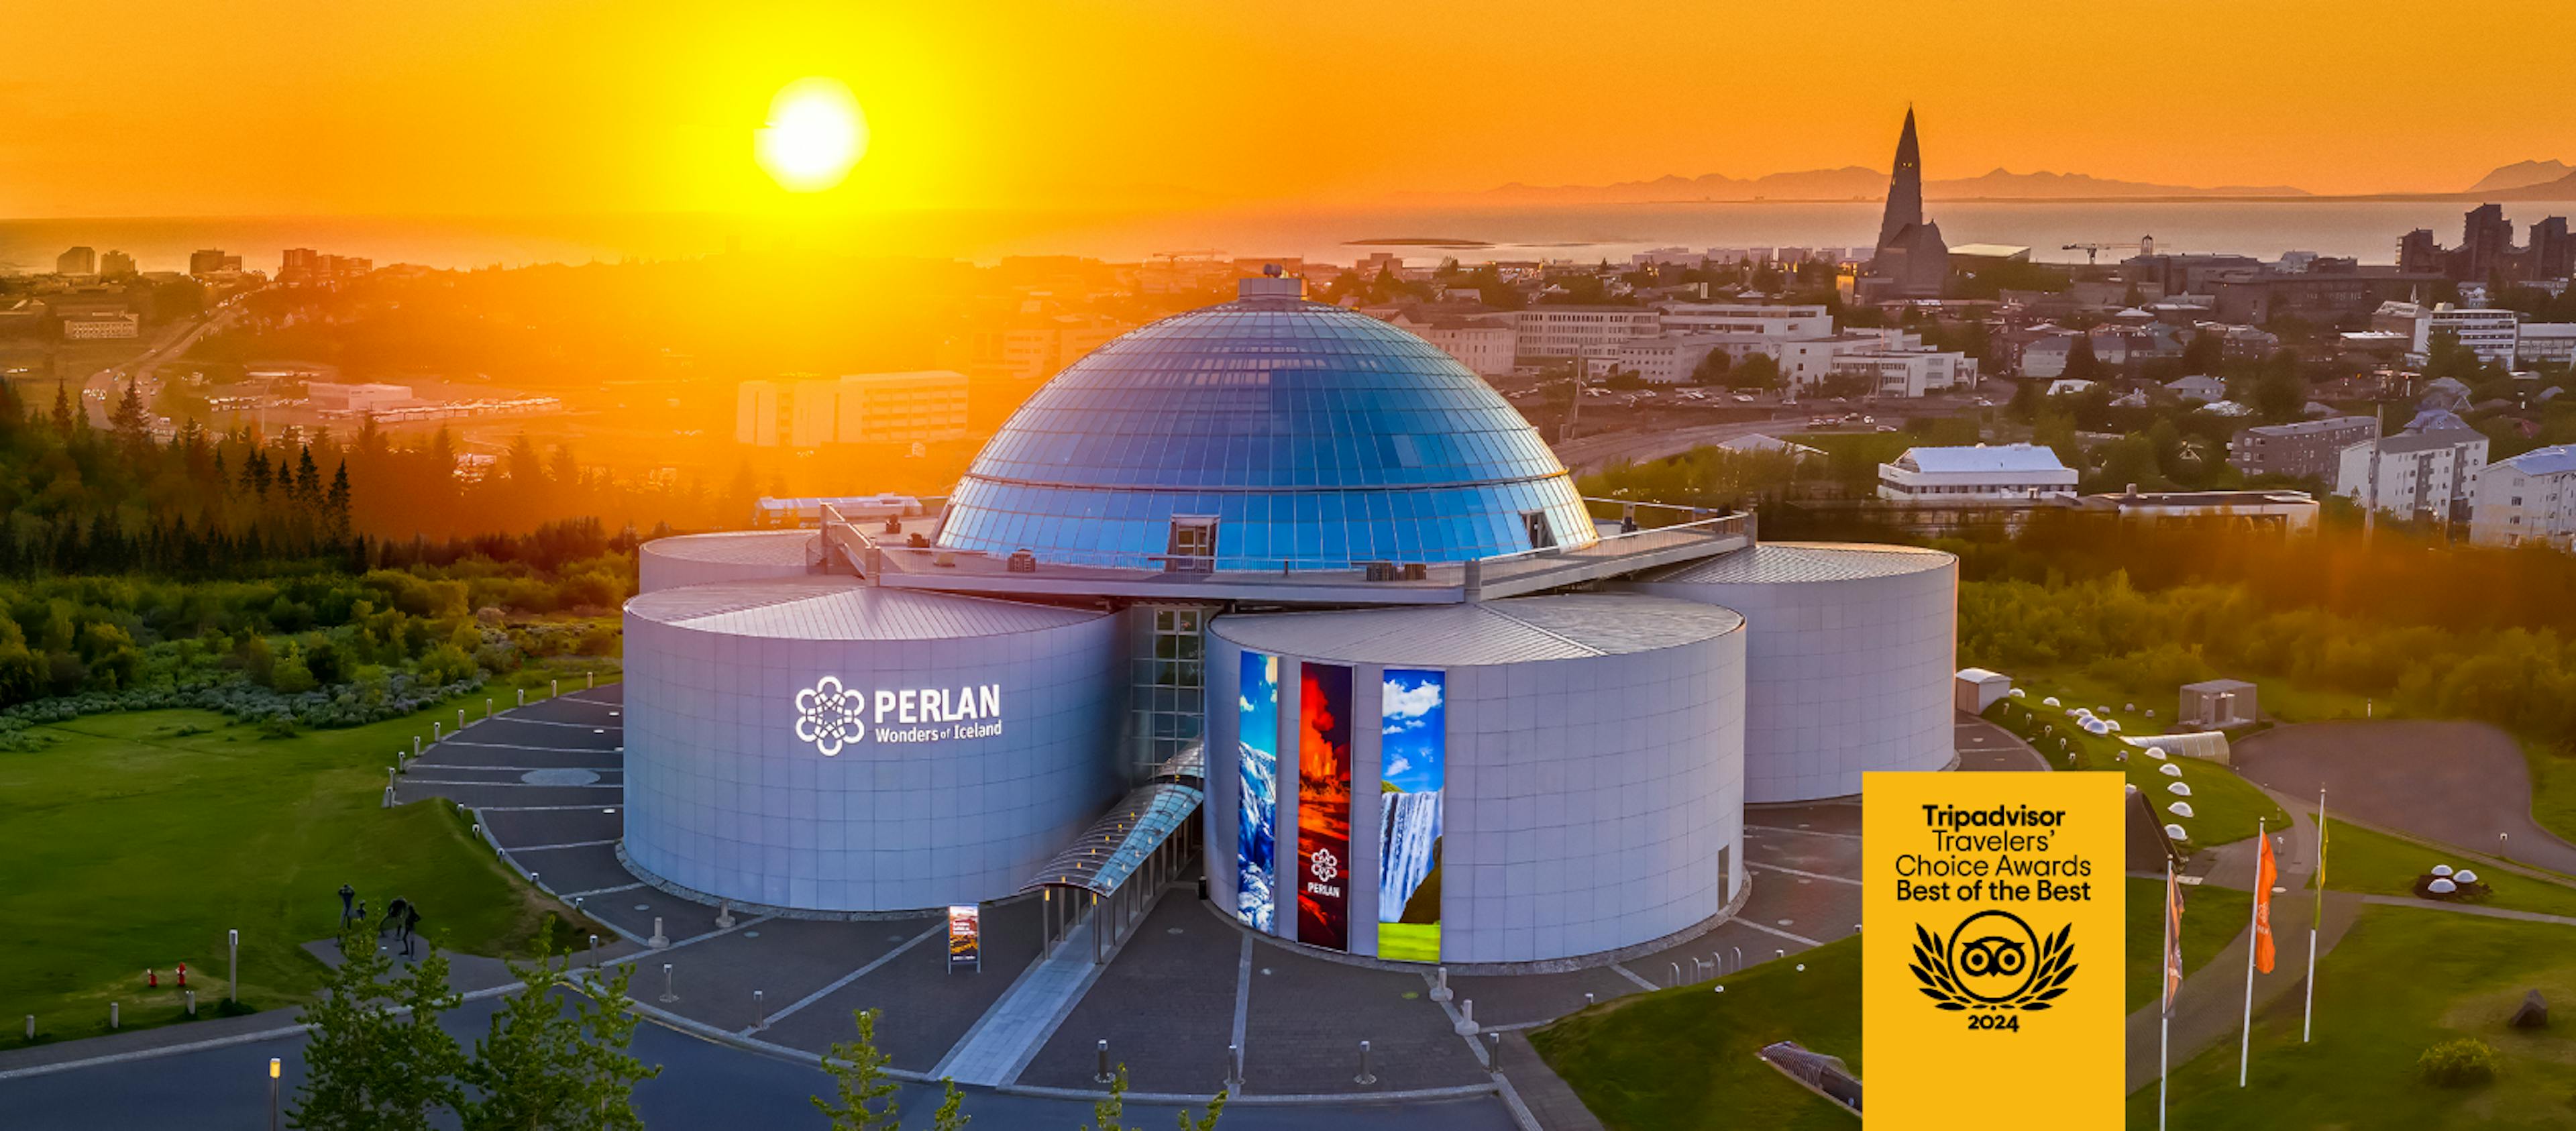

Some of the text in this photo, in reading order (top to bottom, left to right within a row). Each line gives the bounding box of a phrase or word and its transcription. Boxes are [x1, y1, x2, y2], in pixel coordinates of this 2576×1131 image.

[875, 684, 1000, 723] PERLAN
[875, 720, 1002, 743] Wonders of Iceland
[1307, 882, 1340, 898] PERLAN
